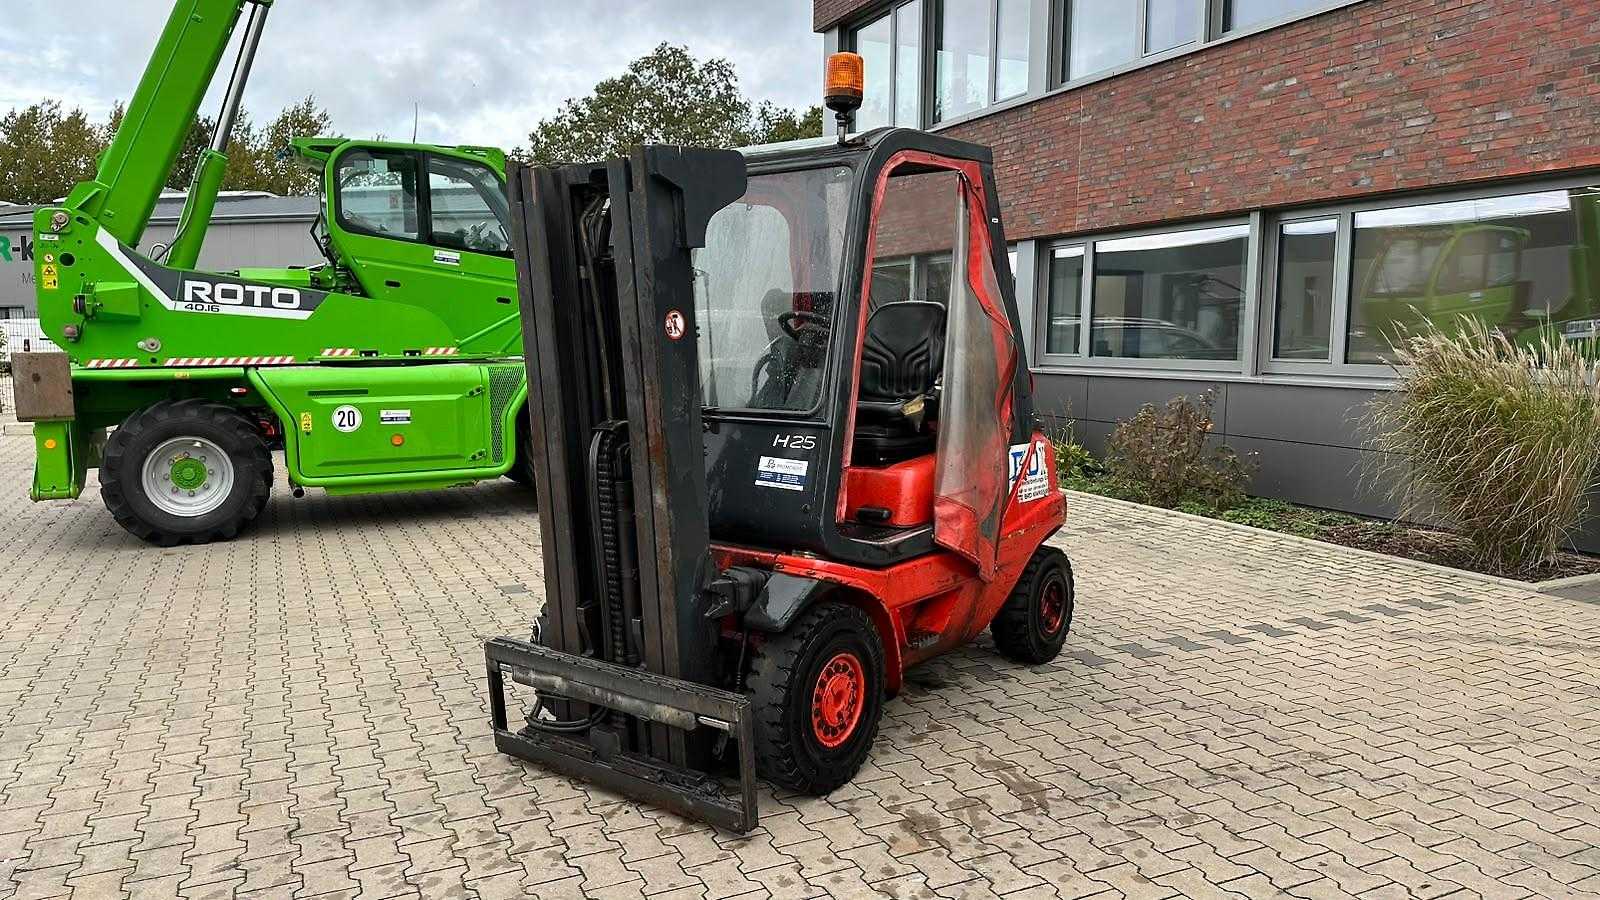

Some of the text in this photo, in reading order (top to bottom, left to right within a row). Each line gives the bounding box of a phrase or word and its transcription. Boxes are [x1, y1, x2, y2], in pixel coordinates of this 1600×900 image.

[184, 280, 301, 309] ROTO
[184, 303, 220, 312] 40.16
[337, 410, 356, 428] 20
[772, 433, 817, 450] H25
